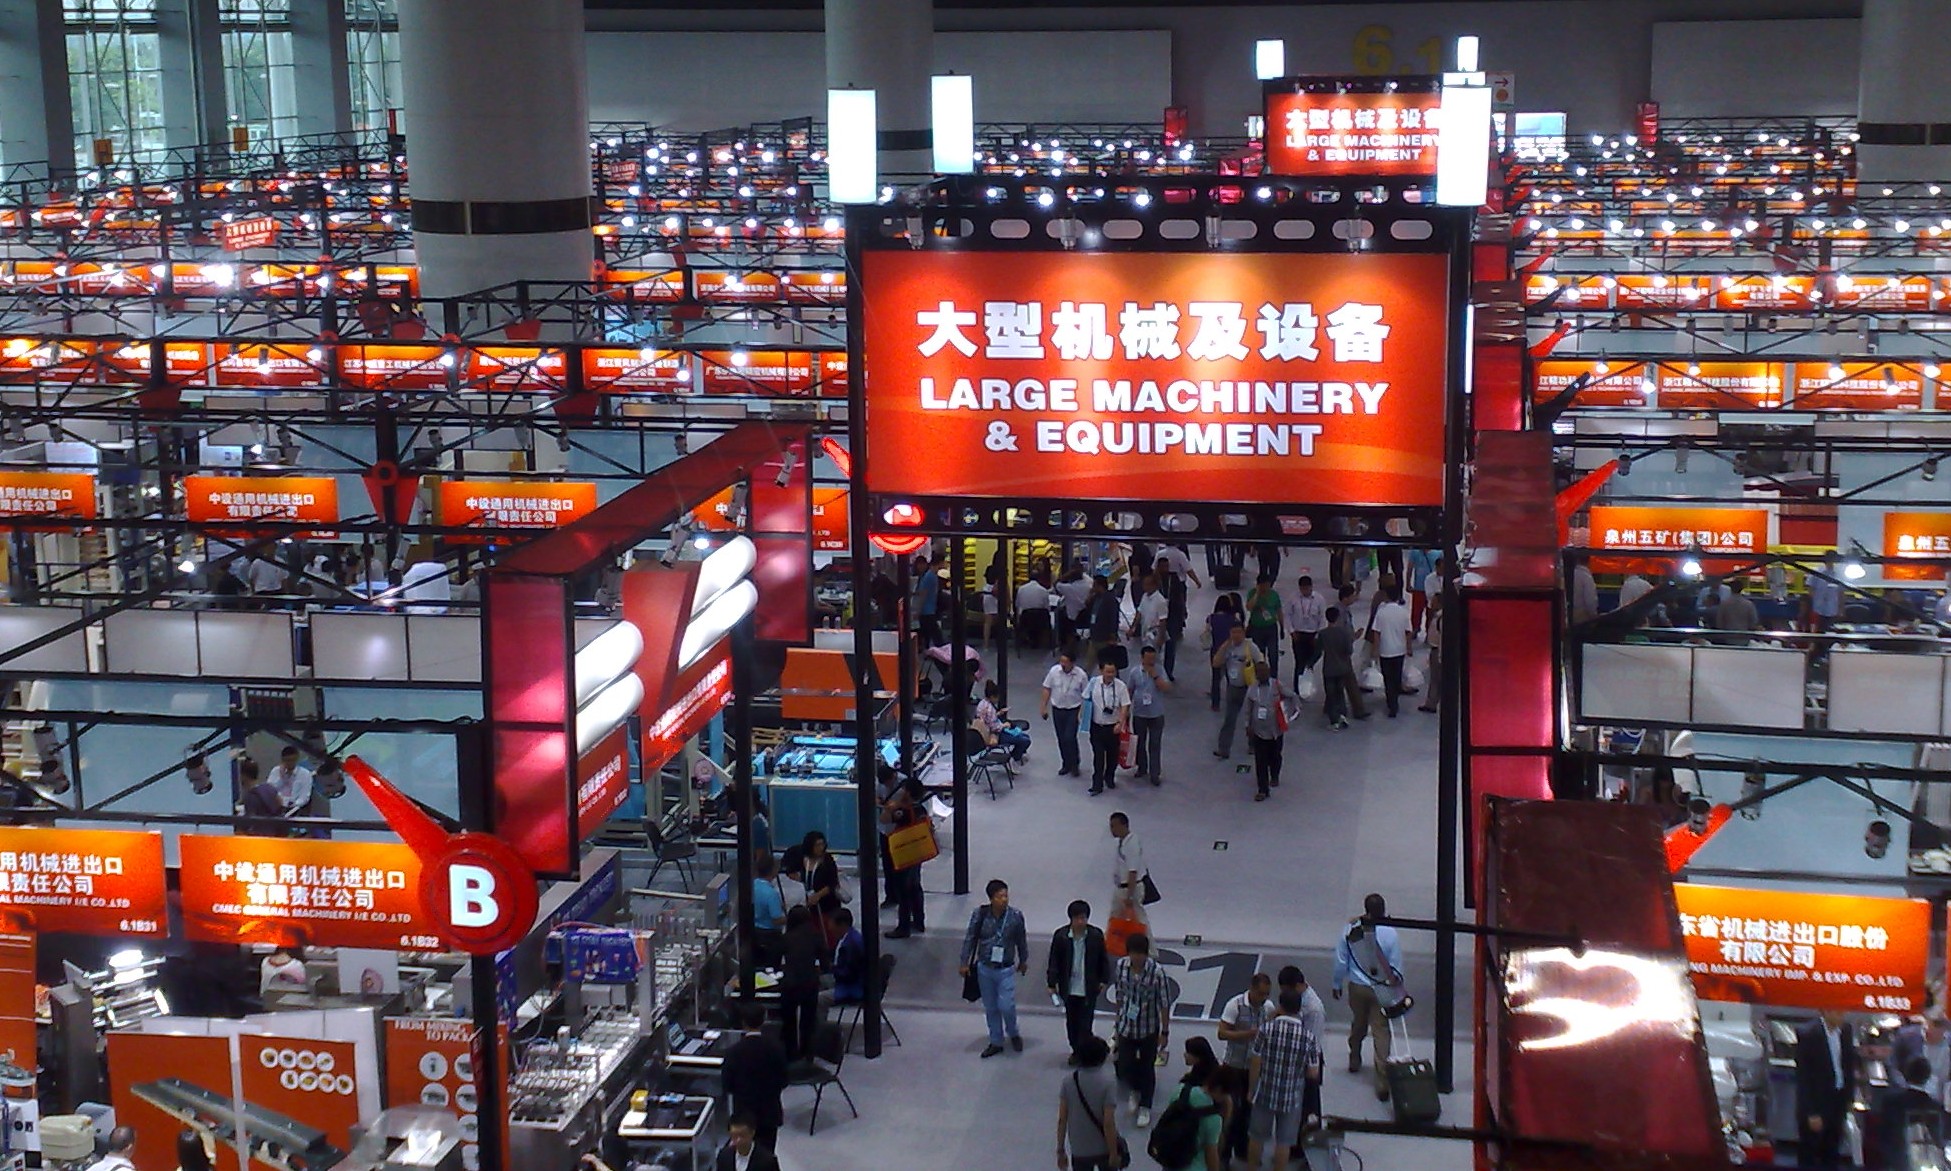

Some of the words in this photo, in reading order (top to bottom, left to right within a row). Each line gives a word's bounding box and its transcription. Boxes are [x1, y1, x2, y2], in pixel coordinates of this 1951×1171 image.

[1286, 134, 1341, 148] LARGE
[1307, 149, 1320, 161] &
[1325, 149, 1422, 161] EQUIPMENT
[917, 301, 1392, 363] 大型机械及设备
[919, 377, 1078, 411] LARGE
[1092, 379, 1390, 414] MACHINERY
[984, 421, 1018, 452] &
[1037, 420, 1323, 457] EQUIPMENT
[247, 883, 374, 909] 有限责任公司
[449, 864, 499, 927] B
[291, 908, 351, 921] MACHINERY
[1720, 940, 1815, 968] 有限公司
[1711, 963, 1782, 979] MACHINERY
